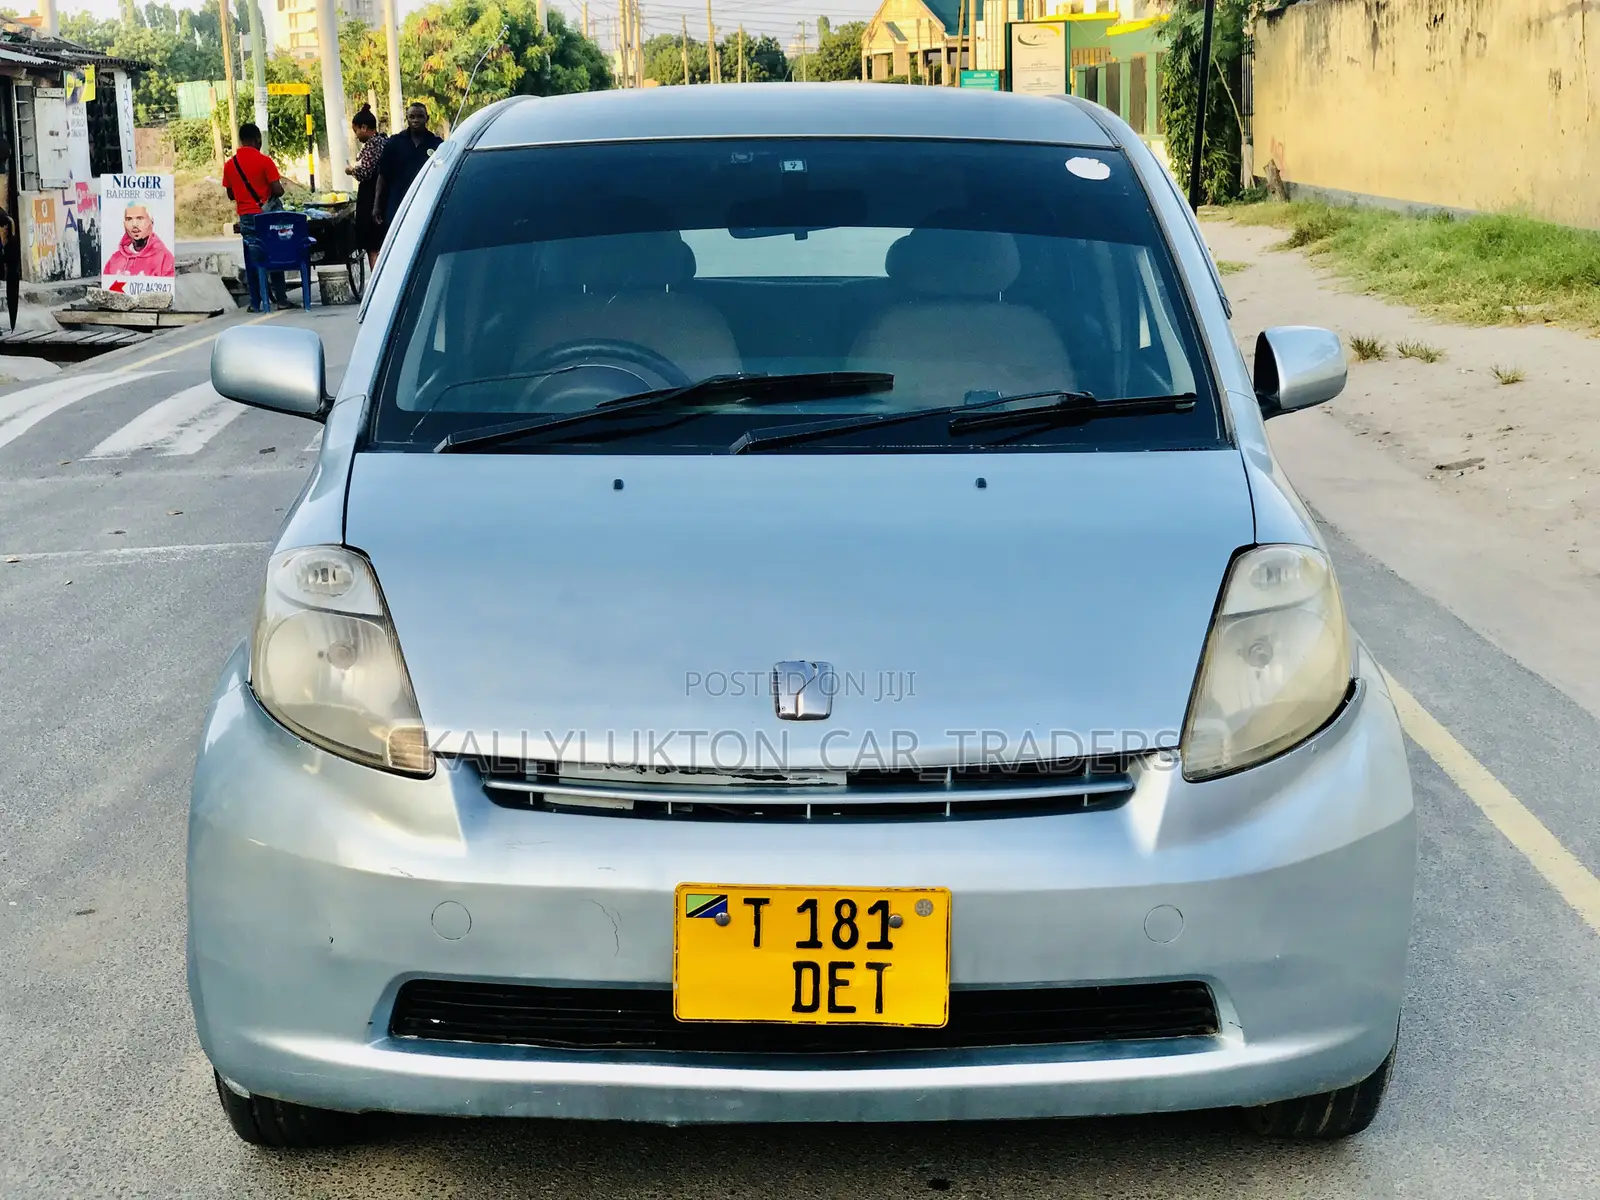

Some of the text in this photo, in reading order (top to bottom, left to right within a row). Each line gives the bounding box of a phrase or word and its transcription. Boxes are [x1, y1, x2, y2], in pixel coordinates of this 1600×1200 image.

[106, 189, 140, 199] BARBER
[144, 190, 166, 200] SHOP
[112, 175, 161, 189] NIGGER
[743, 897, 893, 950] T 181
[791, 960, 893, 1014] DET
